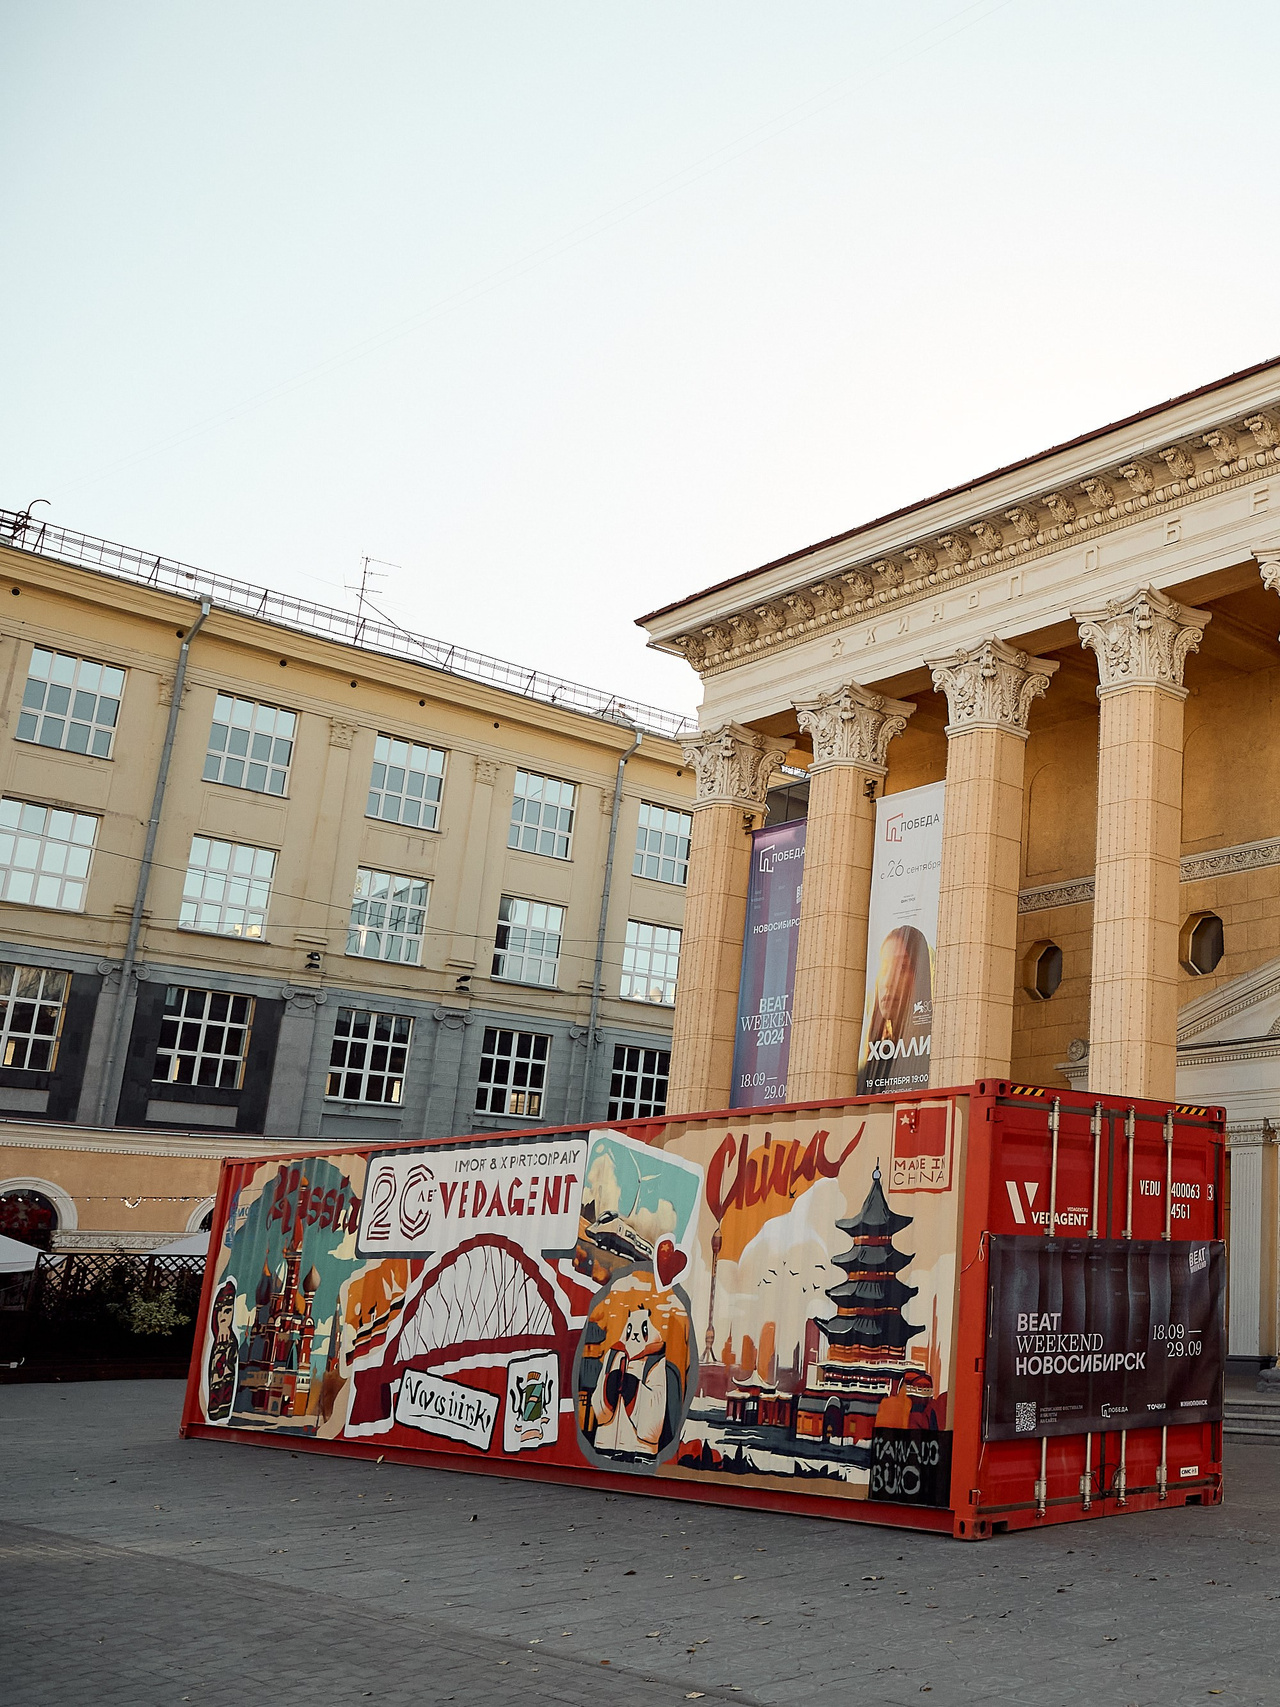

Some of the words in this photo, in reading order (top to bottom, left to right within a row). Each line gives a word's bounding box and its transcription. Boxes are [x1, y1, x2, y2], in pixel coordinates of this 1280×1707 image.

[864, 590, 980, 646] КИНО
[900, 813, 940, 832] ПОБЕДА
[772, 846, 806, 864] ПОБЕДА
[887, 859, 904, 879] 26
[906, 860, 941, 875] сентября
[753, 917, 801, 934] НОВОСИБИРС
[759, 994, 789, 1014] BEAT
[740, 1010, 793, 1032] WEEKEN
[756, 1028, 785, 1047] 2024
[867, 1034, 932, 1062] ХОЛЛИ
[740, 1072, 765, 1088] 18.09
[866, 1079, 873, 1088] 19
[874, 1074, 910, 1087] СЕНТЯБРЯ
[911, 1073, 929, 1083] 19:00
[706, 1121, 866, 1221] China
[439, 1174, 578, 1219] VEDAGENT
[1139, 1179, 1161, 1196] VEDU
[1171, 1182, 1201, 1199] 400063
[1207, 1184, 1214, 1200] 3
[1031, 1211, 1089, 1226] VEDAGENT
[1171, 1203, 1190, 1219] 45G1
[1189, 1247, 1206, 1267] BEAT
[1017, 1313, 1061, 1332] BEAT
[1152, 1324, 1185, 1341] 18.09
[1016, 1333, 1104, 1354] WEEKEND
[1166, 1340, 1202, 1358] 29.09
[1016, 1352, 1146, 1376] НОВОСИБИРСК
